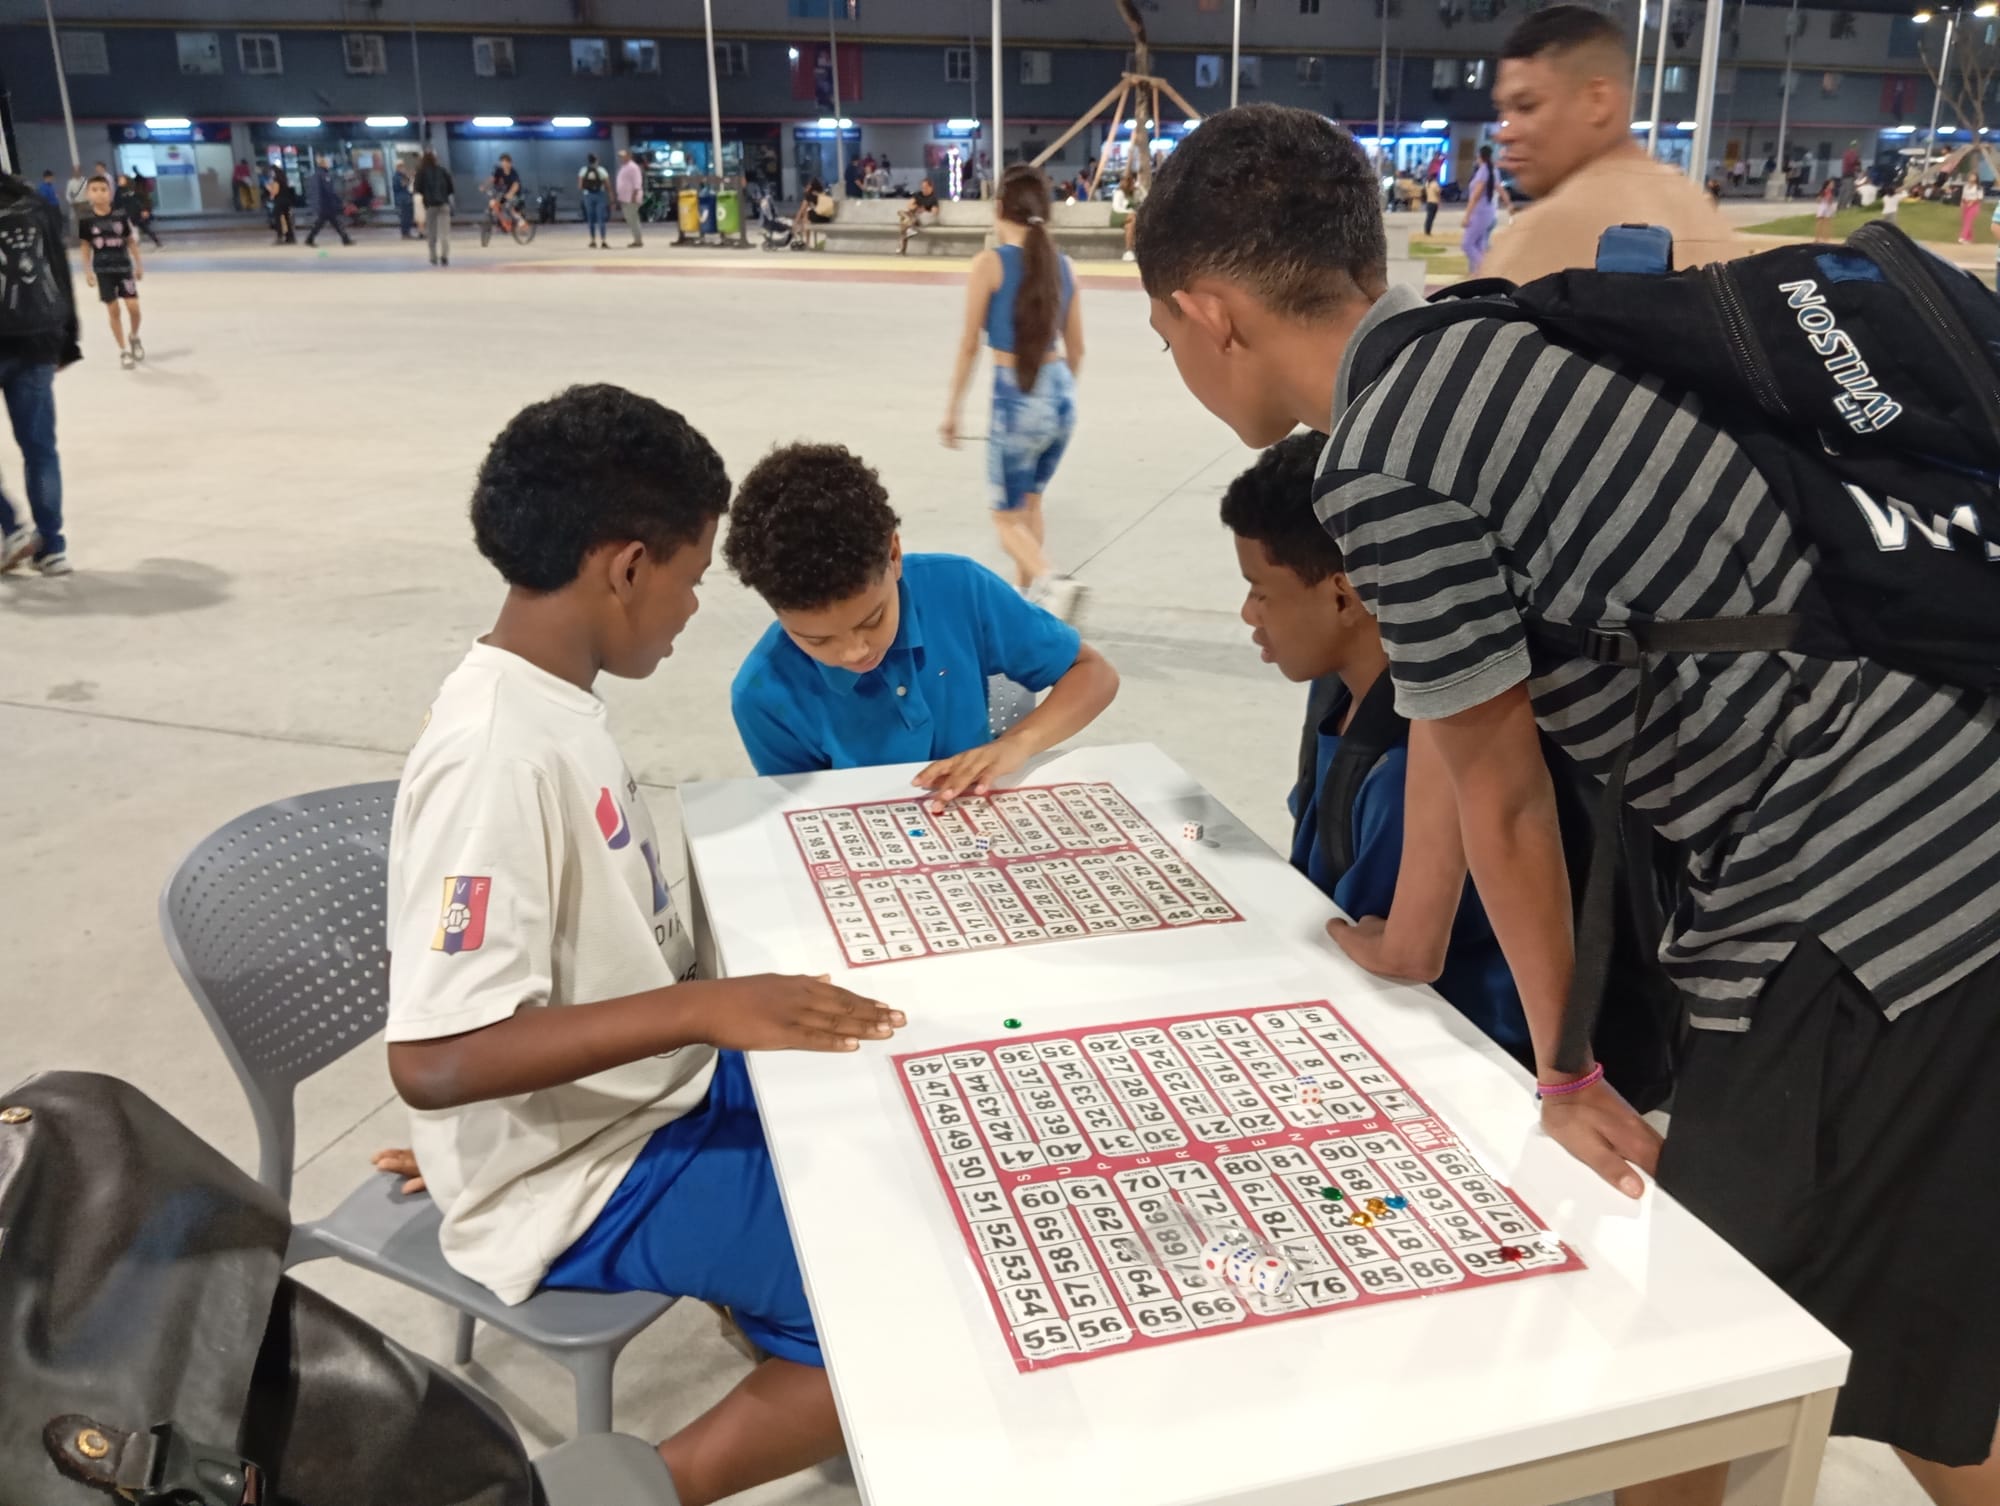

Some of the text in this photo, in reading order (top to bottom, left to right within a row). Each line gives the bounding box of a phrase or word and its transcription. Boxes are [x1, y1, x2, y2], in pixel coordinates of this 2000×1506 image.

[1778, 279, 1903, 430] WILLSON
[1268, 1018, 1284, 1028] 6
[1306, 1013, 1322, 1023] 5
[1177, 1028, 1208, 1040] 16
[1216, 1023, 1248, 1035] 15
[1320, 1032, 1338, 1041] 4
[1089, 1040, 1122, 1052] 26
[1131, 1035, 1164, 1046] 25
[1232, 1041, 1258, 1057] 14
[1001, 1051, 1034, 1064] 36
[1042, 1045, 1075, 1058] 35
[1148, 1051, 1174, 1068] 24
[1197, 1044, 1224, 1059] 17
[1340, 1053, 1360, 1062] 3
[909, 1062, 943, 1076] 46
[953, 1057, 985, 1069] 45
[1056, 1063, 1082, 1080] 34
[1107, 1056, 1134, 1073] 27
[1251, 1062, 1276, 1078] 13
[1304, 1059, 1324, 1068] 8
[1018, 1068, 1044, 1084] 37
[1163, 1072, 1191, 1091] 23
[1214, 1065, 1240, 1083] 18
[1361, 1075, 1383, 1084] 2
[926, 1081, 950, 1097] 47
[965, 1075, 989, 1092] 44
[1121, 1078, 1149, 1097] 28
[1269, 1083, 1293, 1102] 12
[1323, 1080, 1344, 1090] 9
[1031, 1090, 1056, 1110] 38
[1071, 1085, 1097, 1104] 33
[1232, 1089, 1259, 1107] 19
[936, 1103, 961, 1124] 48
[977, 1096, 1000, 1116] 43
[1136, 1102, 1165, 1122] 29
[1180, 1095, 1208, 1115] 22
[1331, 1102, 1366, 1115] 10
[1044, 1115, 1070, 1135] 39
[1085, 1108, 1112, 1128] 32
[1240, 1114, 1276, 1128] 20
[989, 1121, 1014, 1141] 42
[1144, 1128, 1181, 1143] 30
[1196, 1121, 1231, 1136] 21
[948, 1130, 972, 1150] 49
[1100, 1136, 1133, 1149] 31
[1365, 1139, 1402, 1154] 91
[1001, 1151, 1034, 1164] 41
[1046, 1143, 1082, 1157] 40
[1320, 1145, 1357, 1161] 90
[959, 1156, 985, 1178] 50
[1224, 1160, 1262, 1175] 80
[1272, 1152, 1307, 1168] 81
[1436, 1153, 1469, 1175] 99
[1169, 1168, 1207, 1183] 71
[1341, 1169, 1373, 1191] 89
[1395, 1160, 1427, 1183] 92
[1071, 1184, 1108, 1199] 61
[1120, 1175, 1160, 1192] 70
[1462, 1181, 1496, 1203] 98
[974, 1191, 1002, 1213] 51
[1021, 1191, 1060, 1208] 60
[1197, 1189, 1227, 1215] 72
[1242, 1183, 1273, 1206] 79
[1419, 1188, 1453, 1211] 93
[1093, 1207, 1123, 1231] 62
[1262, 1212, 1295, 1239] 78
[1486, 1210, 1524, 1233] 97
[987, 1224, 1016, 1249] 52
[1034, 1217, 1063, 1240] 59
[1445, 1216, 1481, 1242] 94
[1343, 1234, 1378, 1258] 84
[1386, 1228, 1423, 1250] 87
[1001, 1256, 1030, 1281] 53
[1049, 1247, 1079, 1273] 58
[1410, 1259, 1453, 1278] 86
[1128, 1270, 1161, 1297] 64
[1361, 1267, 1403, 1286] 85
[1063, 1283, 1097, 1307] 57
[1301, 1277, 1346, 1297] 76
[1016, 1288, 1048, 1316] 54
[1192, 1298, 1235, 1316] 66
[1139, 1306, 1182, 1326] 65
[1078, 1317, 1122, 1338] 56
[1023, 1326, 1067, 1349] 55
